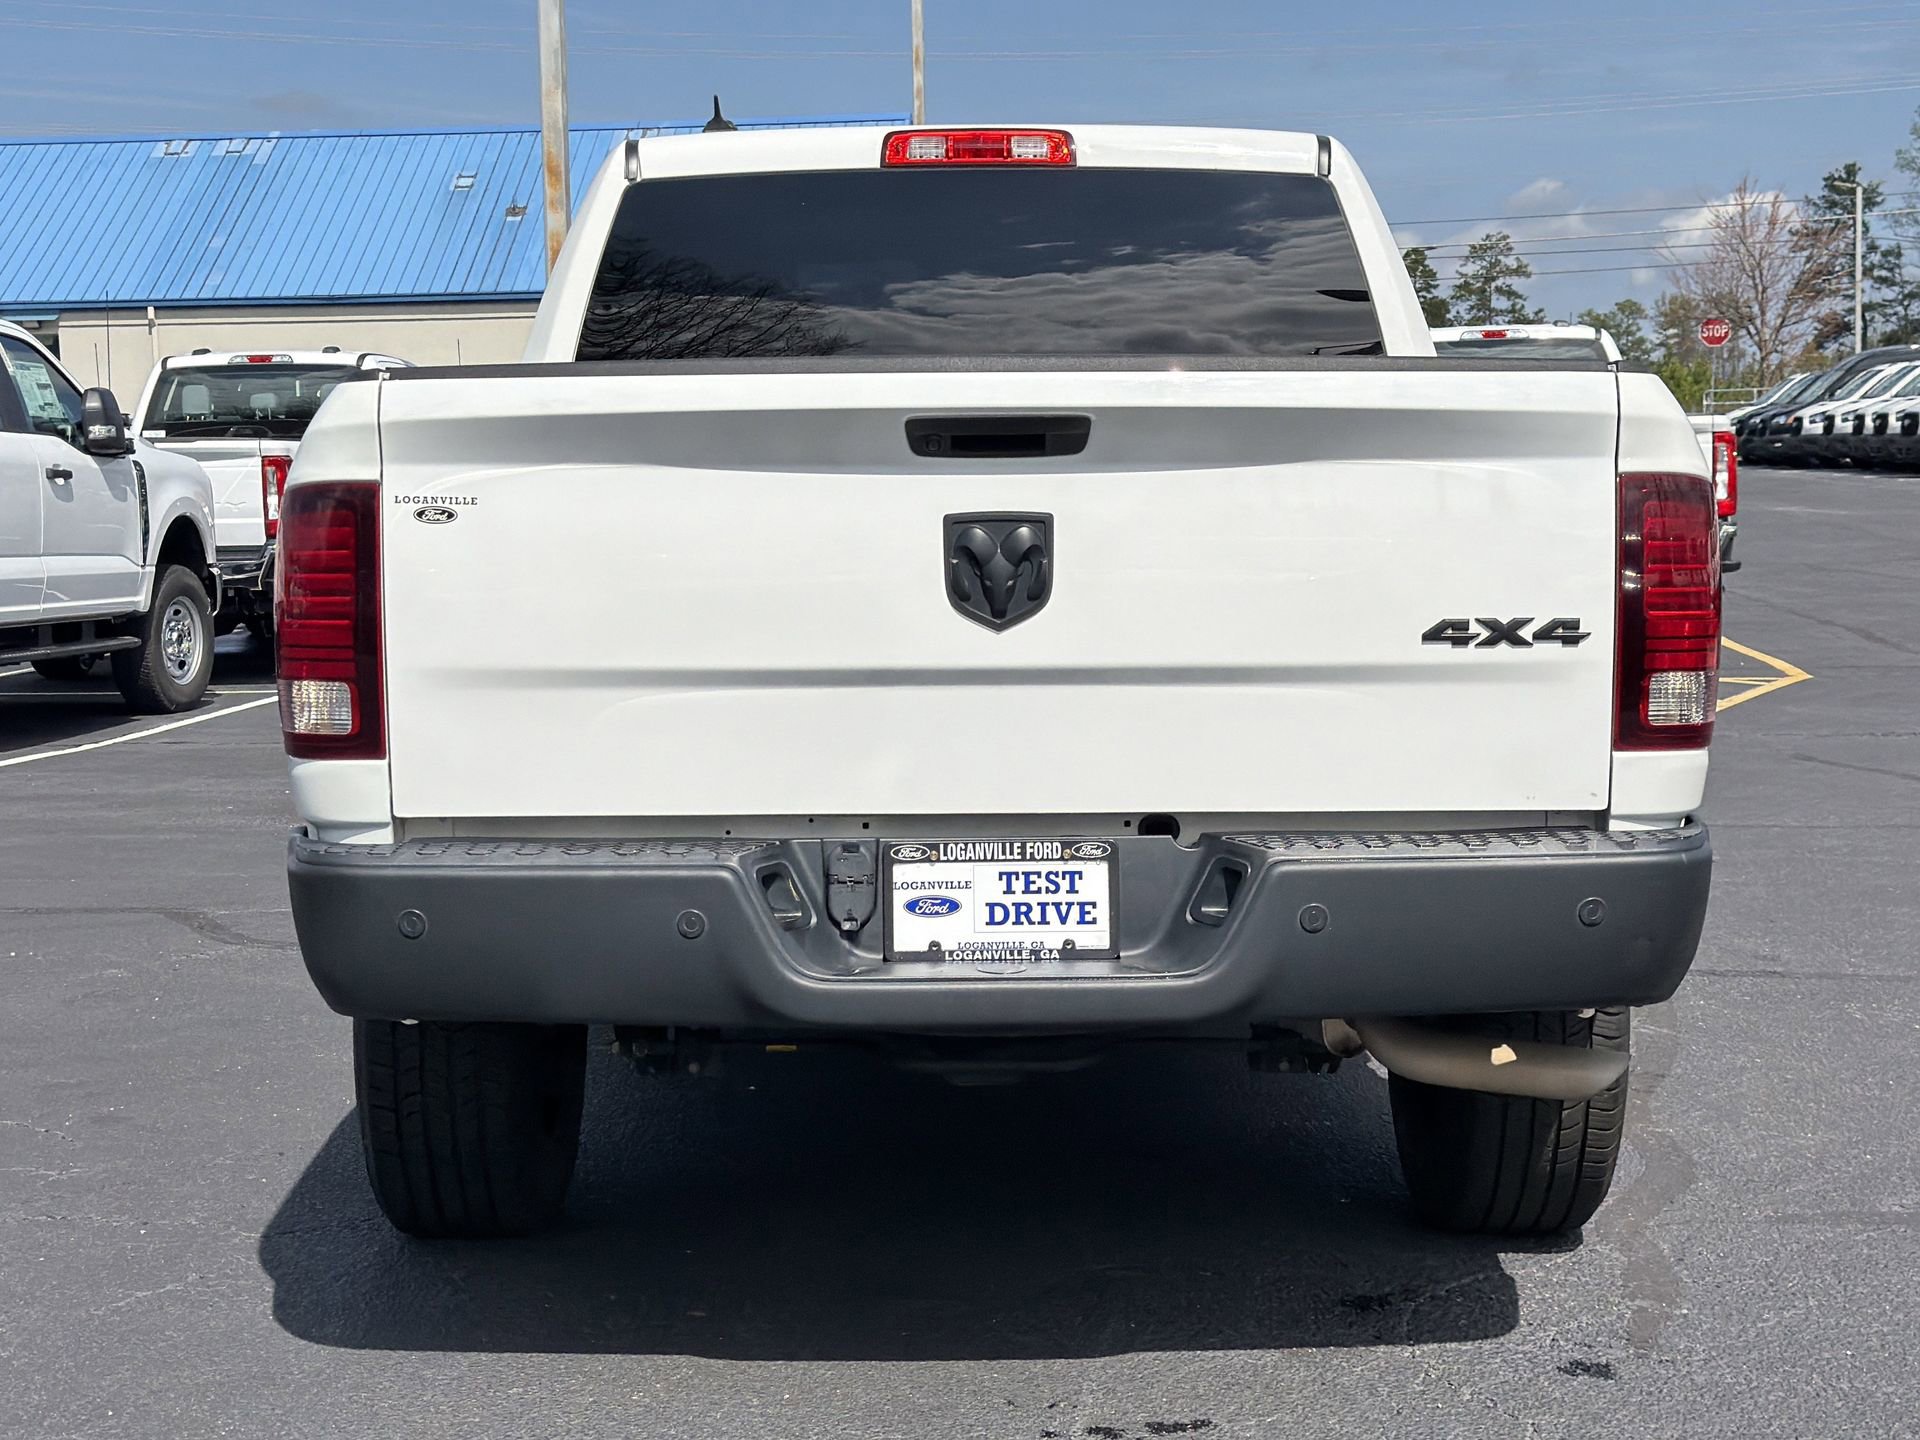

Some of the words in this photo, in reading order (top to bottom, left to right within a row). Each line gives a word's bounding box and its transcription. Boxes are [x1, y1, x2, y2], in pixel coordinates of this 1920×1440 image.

[1702, 325, 1728, 337] STOP
[394, 495, 478, 505] LOGANVILLE
[421, 509, 449, 520] Ford
[898, 847, 923, 858] Ford
[939, 842, 1022, 861] LOGANVILLE
[1026, 842, 1062, 860] FORD
[1079, 844, 1103, 856] Ford
[893, 880, 972, 890] LOGANVILLE
[998, 870, 1083, 895] TEST
[915, 899, 950, 915] Ford
[985, 901, 1097, 926] DRIVE
[1031, 941, 1046, 950] GA
[944, 950, 1035, 962] LOGANVILLE,
[1040, 949, 1061, 960] GA
